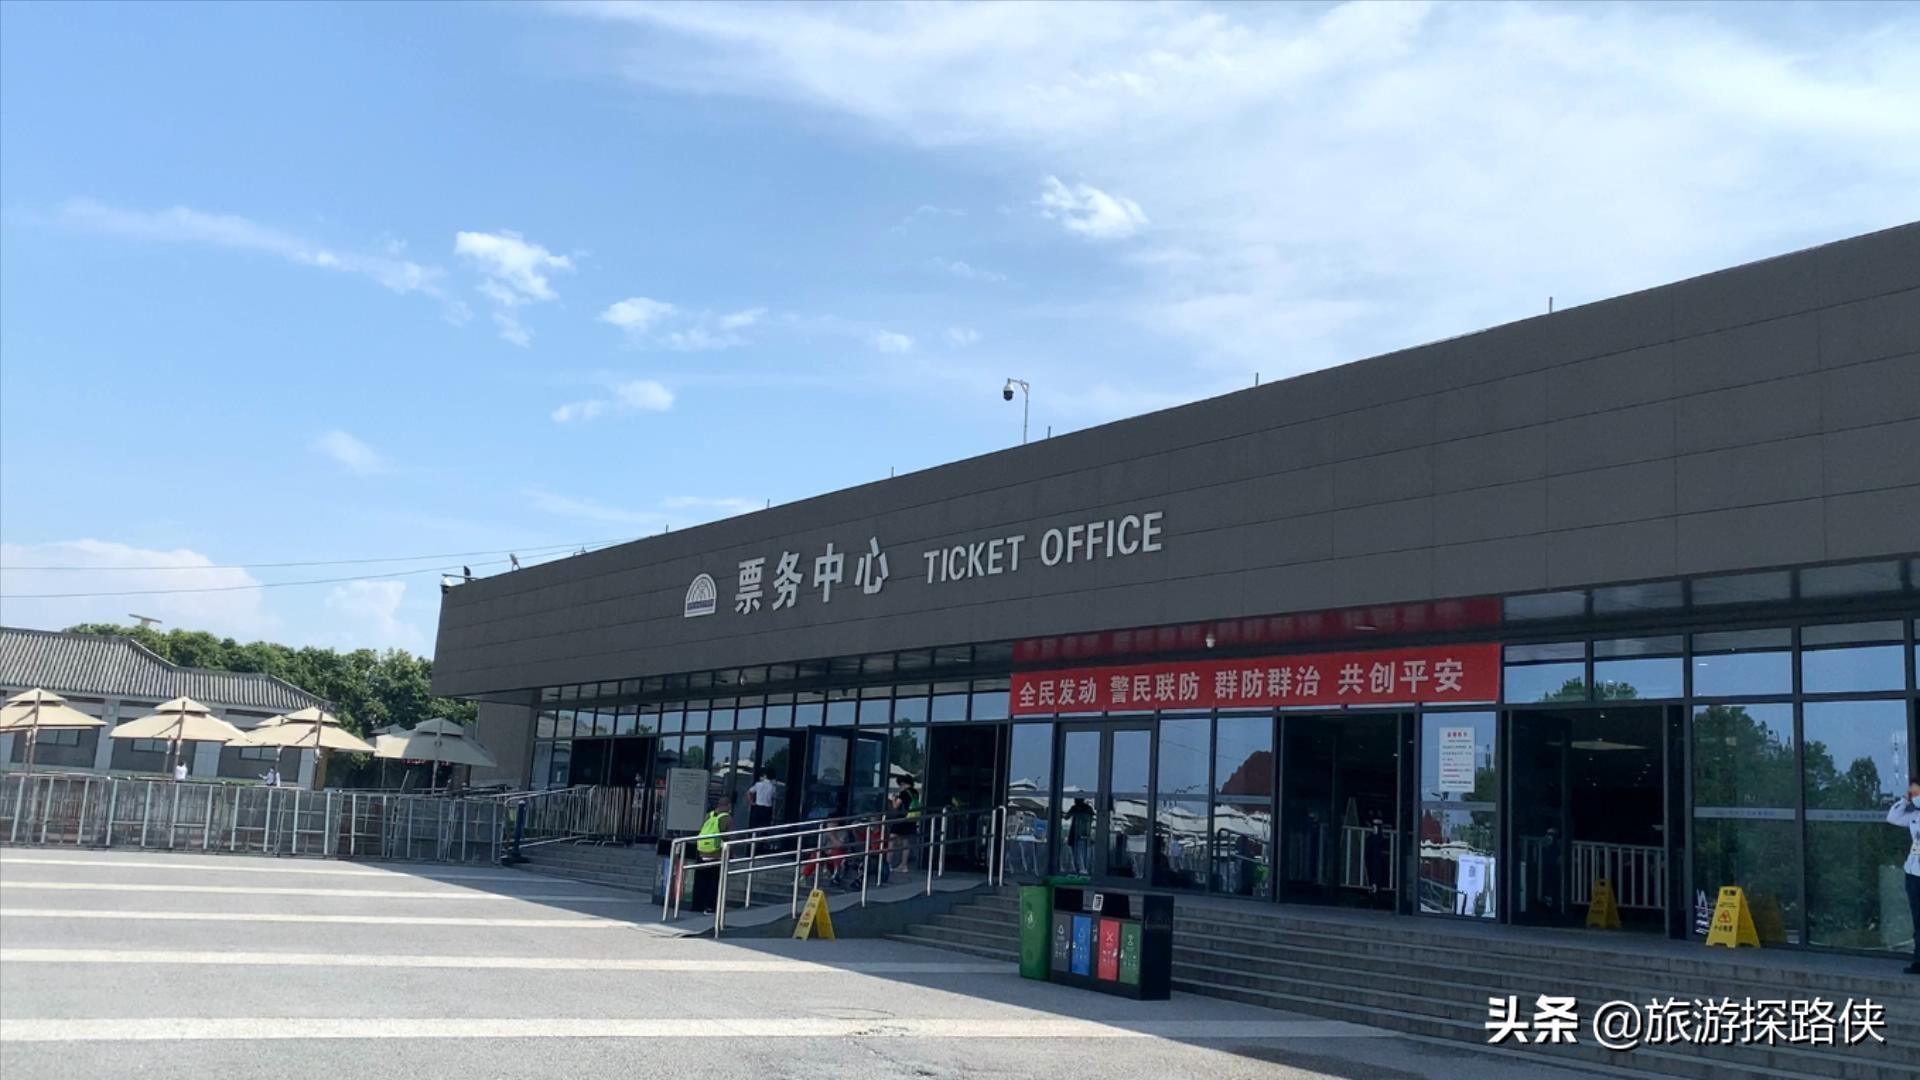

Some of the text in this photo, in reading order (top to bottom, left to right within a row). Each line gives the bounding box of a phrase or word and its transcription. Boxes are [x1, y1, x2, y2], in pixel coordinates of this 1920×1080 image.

[734, 536, 889, 616] 票务中心
[923, 511, 1163, 584] TICKET OFFICE
[1019, 658, 1463, 707] 全民发动 警民联防 群防群治 共创平安
